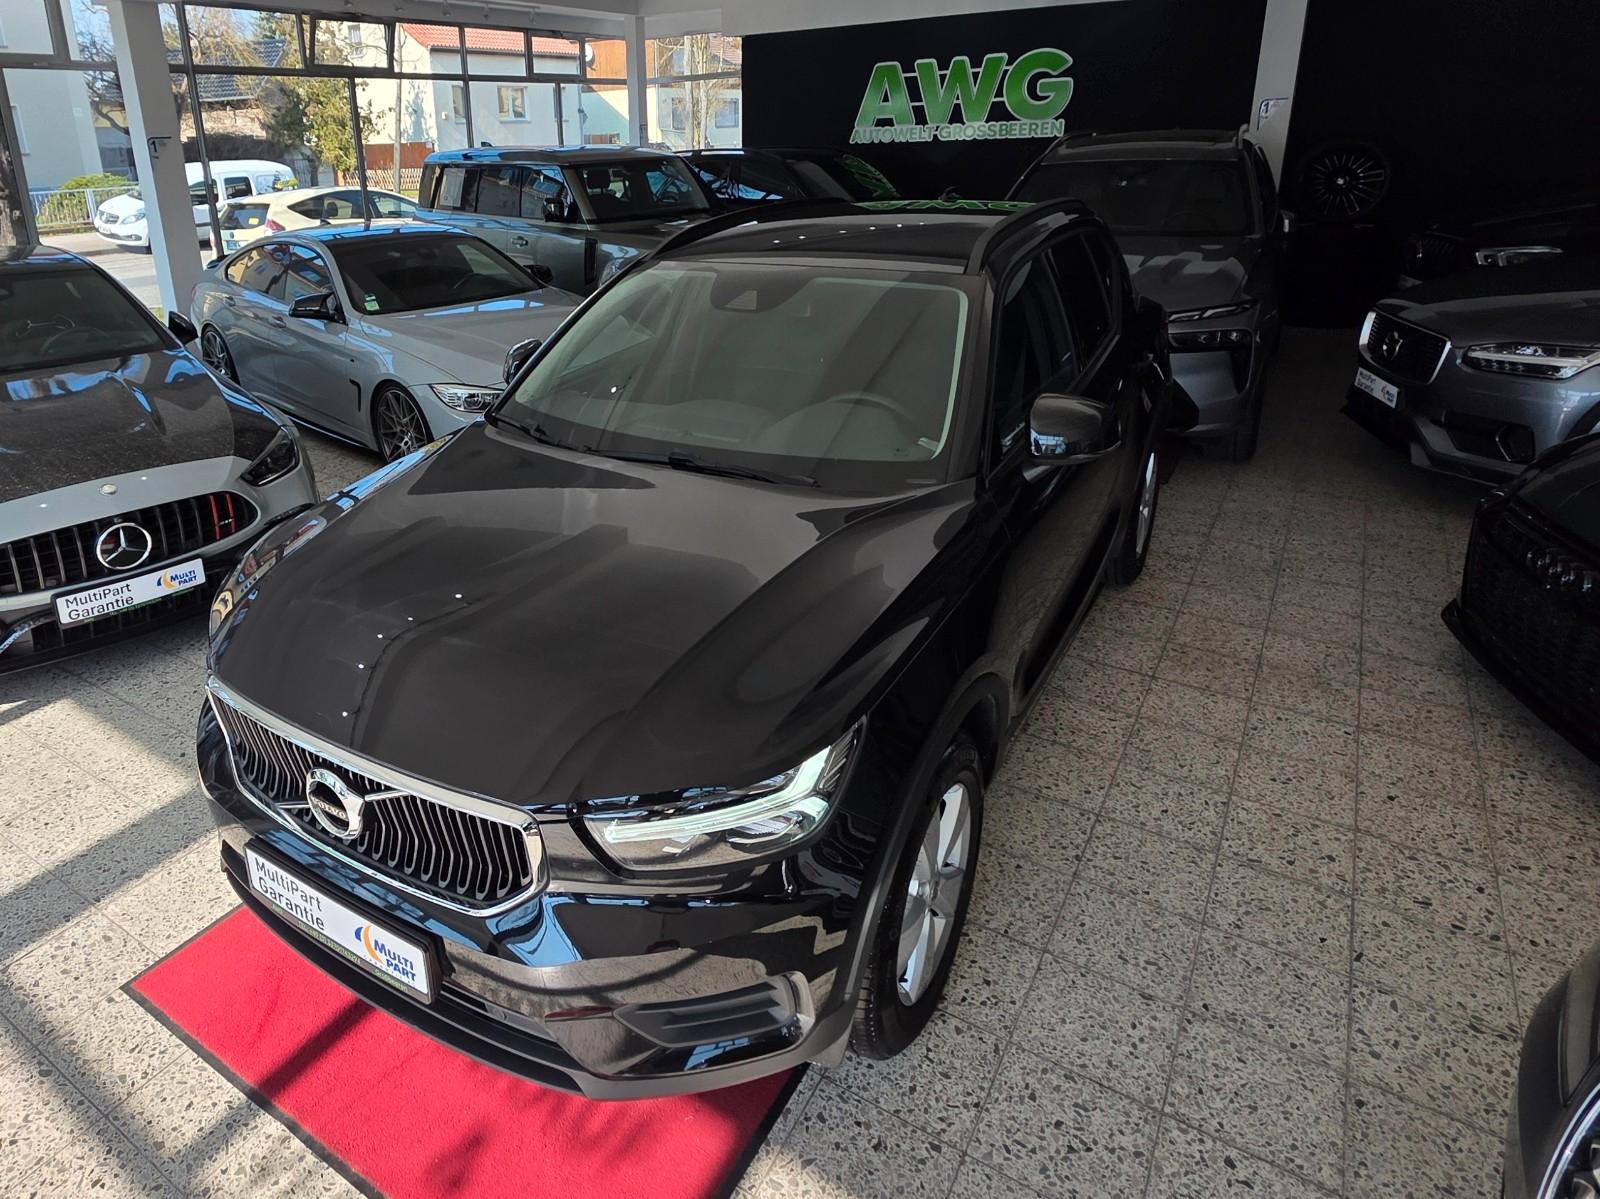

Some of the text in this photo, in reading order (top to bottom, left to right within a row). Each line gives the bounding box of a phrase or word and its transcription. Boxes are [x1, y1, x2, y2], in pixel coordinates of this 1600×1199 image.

[854, 47, 1074, 128] AWG
[850, 119, 1064, 144] AUTOWELT GROSSBEEREN
[170, 569, 196, 583] MULTI
[178, 575, 197, 586] PART
[65, 583, 132, 609] MultiPart
[68, 595, 135, 621] Garantie
[254, 856, 323, 912] MultiPart
[258, 876, 326, 931] Garantie
[374, 938, 414, 971] MULTI
[385, 958, 417, 982] PART
